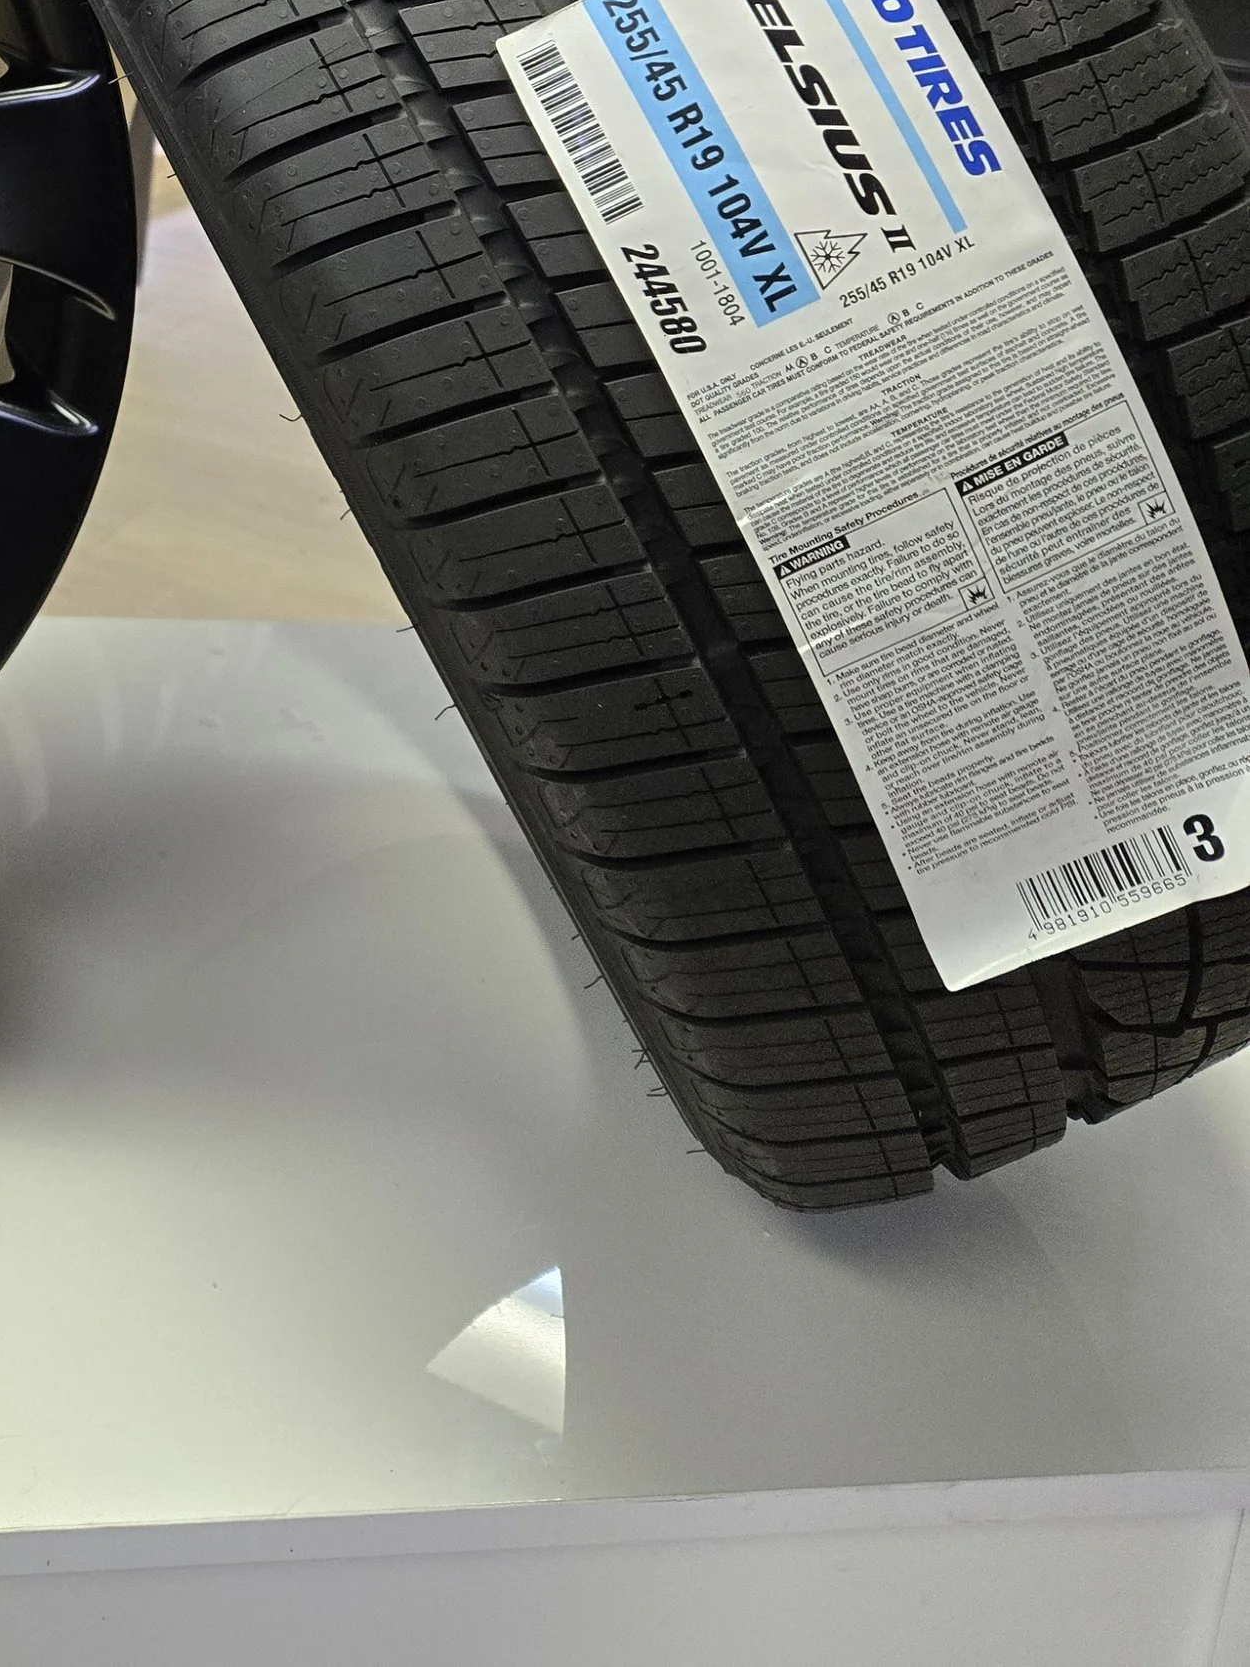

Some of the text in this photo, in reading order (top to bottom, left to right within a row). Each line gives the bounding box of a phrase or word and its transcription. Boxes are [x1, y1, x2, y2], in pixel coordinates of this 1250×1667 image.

[896, 25, 999, 174] TIRES
[667, 102, 724, 170] R19
[708, 174, 775, 257] 104V
[752, 261, 797, 312] XL
[620, 244, 706, 353] 244580
[690, 240, 745, 325] 1001-1804
[840, 235, 975, 308] 255/45 R19 104V XL
[693, 393, 732, 415] TREADWEAR
[735, 386, 751, 398] 560
[750, 370, 782, 389] TRACTION
[784, 363, 795, 372] AA
[809, 352, 818, 361] B
[823, 345, 832, 354] C
[834, 324, 880, 349] TEMPERATURE
[901, 308, 910, 317] B
[915, 301, 924, 310] C
[698, 250, 1054, 424] ALL PASSENGER CAR TIRES MUST CONFORM TO FEDERAL SAFETY REQUIREMENTS IN ADDITION TO THESE GRADES
[749, 349, 785, 370] CONCERNE
[784, 343, 798, 354] LES
[814, 317, 852, 340] SEULEMENT
[857, 334, 907, 361] TREADWEAR
[686, 372, 736, 401] FOR U.S.A. ONLY
[690, 371, 759, 408] DOT QUALITY GRADES
[880, 373, 921, 395] TRACTION
[889, 406, 948, 437] TEMPERATURE
[987, 453, 998, 462] de
[1024, 426, 1053, 444] relatives
[1052, 422, 1062, 431] au
[1061, 408, 1090, 426] montage
[1090, 401, 1103, 412] des
[1102, 391, 1125, 407] pneus
[967, 426, 1121, 505] Risque de projection de pièces
[971, 432, 1136, 517] Lors du montage des pneus, suivre
[973, 436, 1063, 485] MISE EN GARDE
[977, 441, 1142, 526] exactement les procédures de sécurité.
[767, 491, 918, 564] Tire Mounting Safety Procedures
[785, 538, 885, 589] Flying parts hazard.
[789, 540, 844, 569] WARNING
[789, 520, 953, 600] When mounting tires, follow safety
[795, 529, 959, 612] procedures exactly. Failure to do so
[800, 540, 965, 620] can cause the tire/rim assembly,
[804, 548, 969, 630] the tire, or the tire bead to fly apart
[809, 559, 974, 640] explosively. Failure to comply with
[814, 569, 977, 650] any of these safety procedures can
[818, 593, 954, 658] cause serious injury or death.
[835, 666, 860, 681] Make
[860, 657, 880, 670] sure
[879, 651, 894, 661] tire
[893, 638, 917, 654] bead
[917, 622, 954, 644] diameter
[956, 613, 973, 627] and
[972, 601, 999, 618] wheel
[839, 631, 960, 689] rim diameter match exactly.
[1105, 804, 1170, 834] recommandée.
[1182, 813, 1225, 862] 3
[1027, 872, 1186, 942] 4 981910 559665
